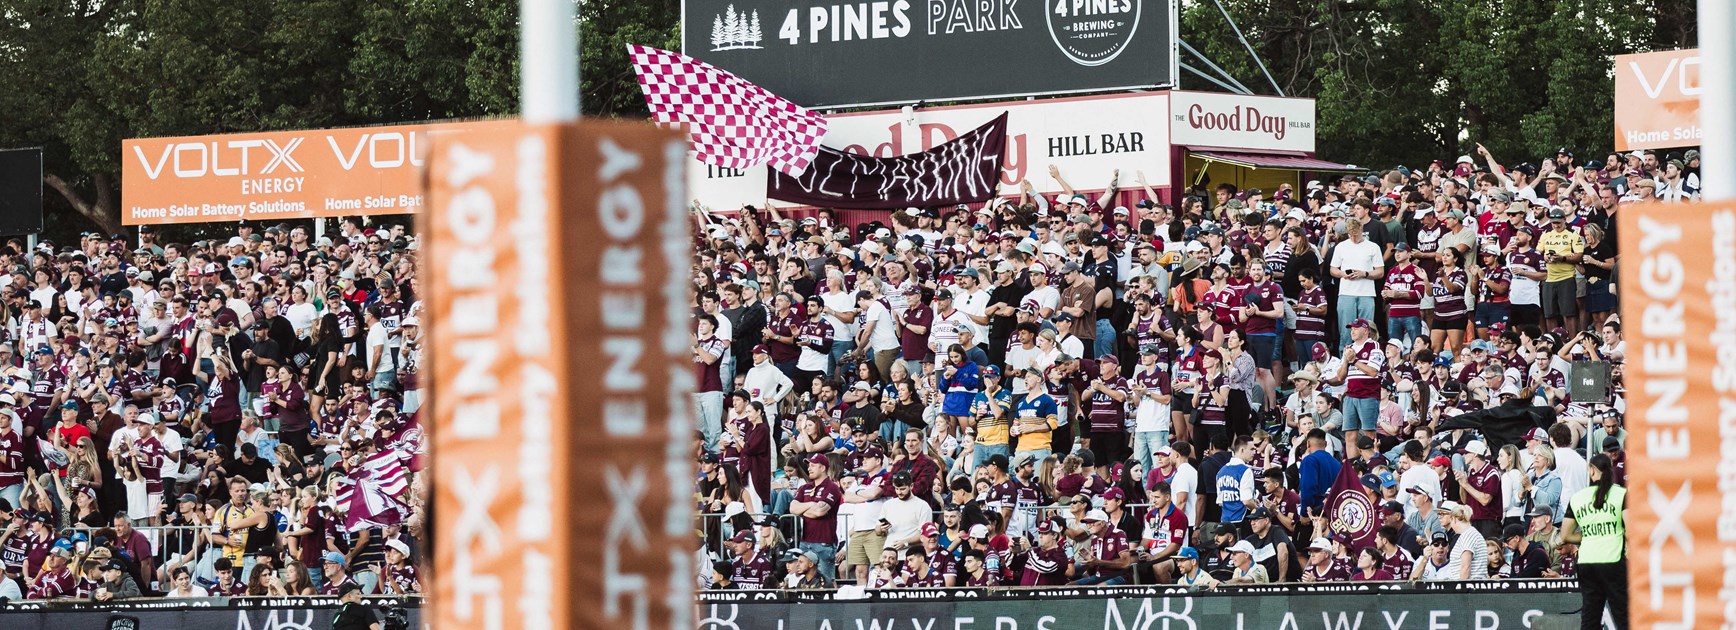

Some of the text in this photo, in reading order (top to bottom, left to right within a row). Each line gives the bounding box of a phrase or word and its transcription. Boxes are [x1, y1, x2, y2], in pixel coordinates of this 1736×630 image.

[1055, 0, 1132, 17] 4 PINES
[779, 0, 1023, 45] 4 PINES PARK
[1073, 20, 1115, 32] BREWING
[1189, 103, 1240, 129] Good
[1246, 107, 1286, 140] Day
[1628, 125, 1703, 143] Home Sola
[326, 131, 425, 170] VOL
[1048, 132, 1144, 157] HILL BAR
[133, 137, 305, 180] VOLTX
[241, 177, 305, 195] ENERGY
[132, 199, 305, 219] Home Solar Battery Solutions
[325, 197, 362, 210] Home
[364, 195, 396, 209] Solar
[448, 140, 499, 440] ENERGY
[599, 137, 647, 438] ENERGY
[1638, 215, 1690, 459] ENERGY
[1582, 521, 1618, 537] ECURITY
